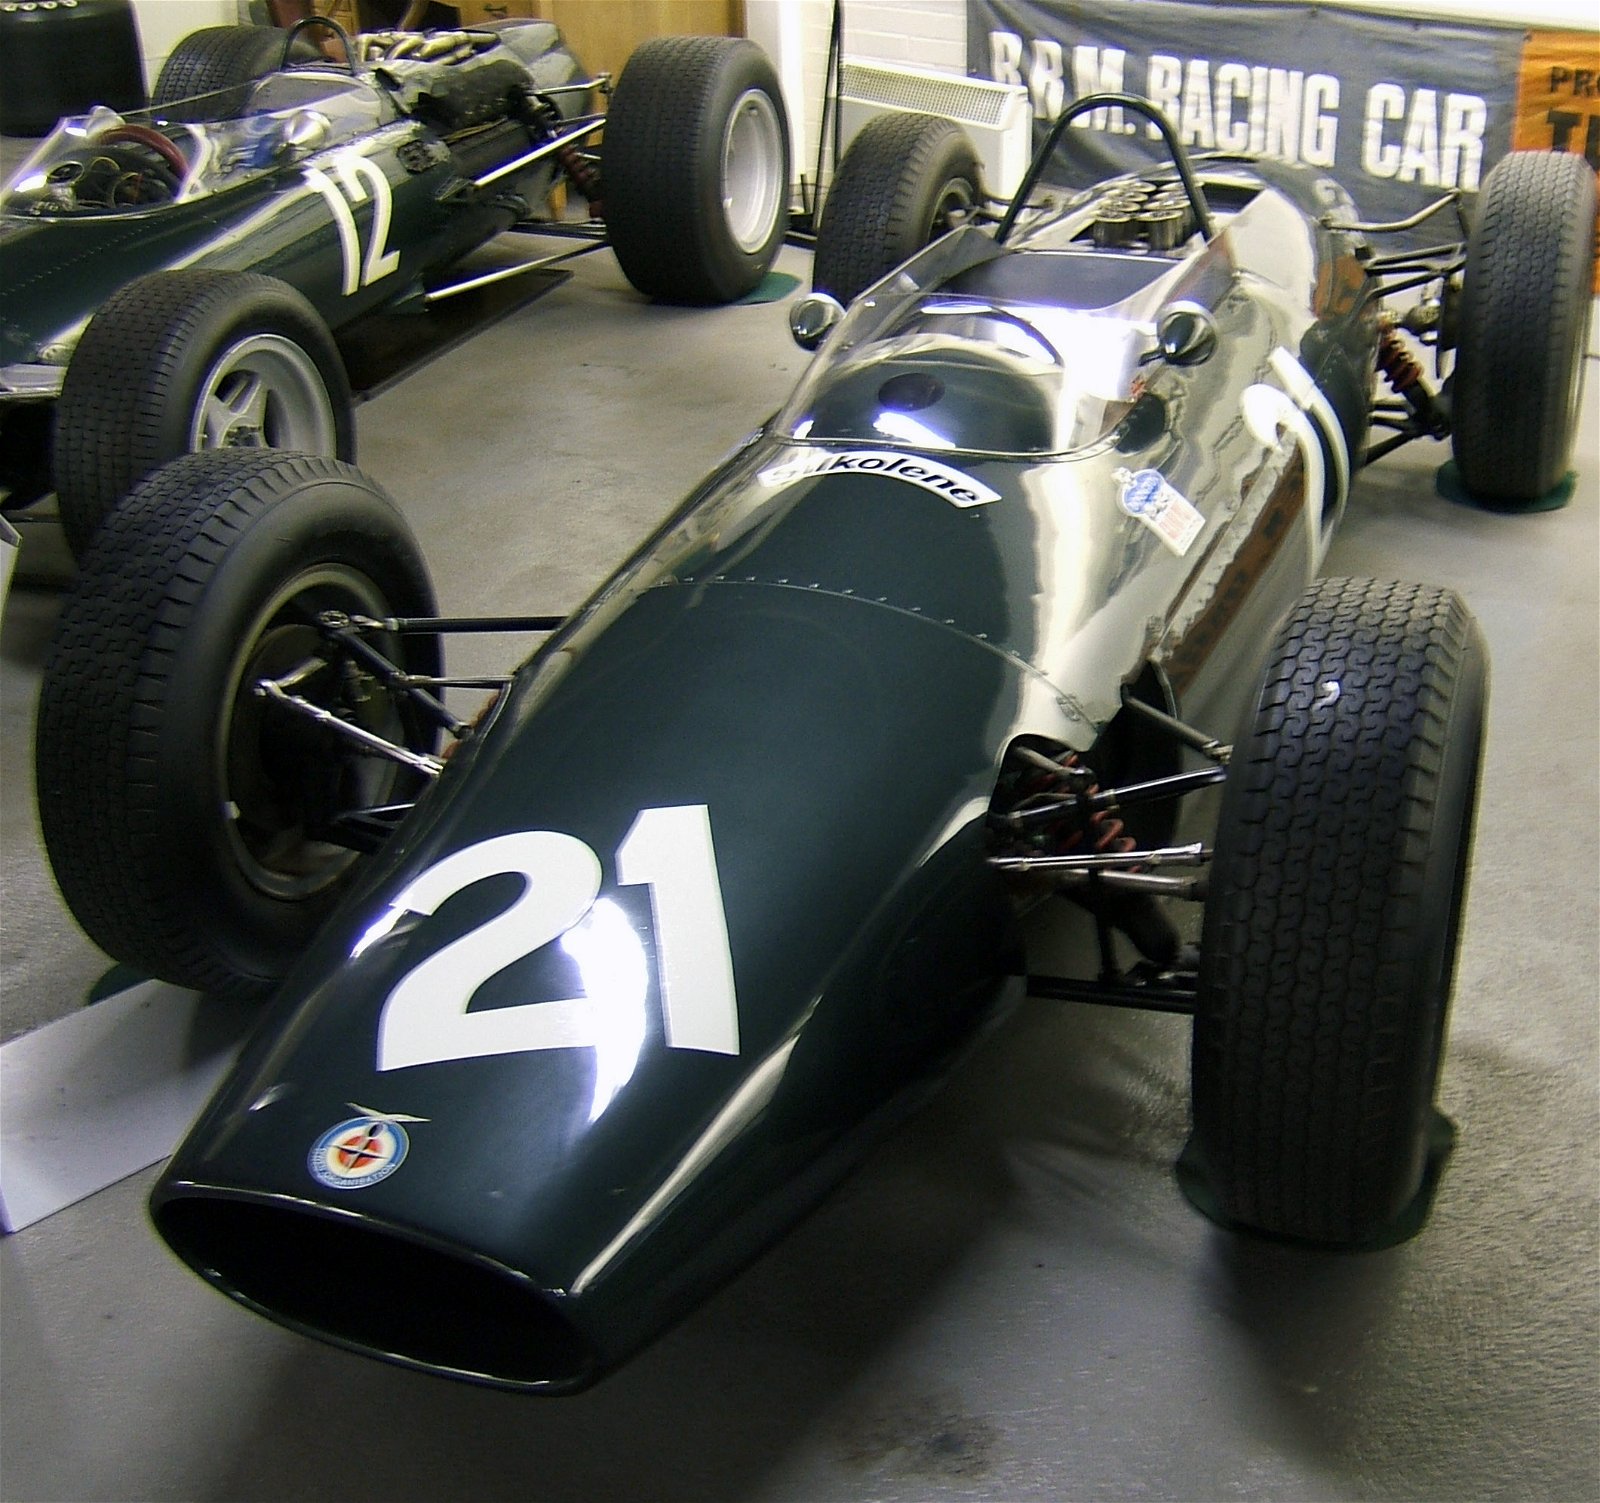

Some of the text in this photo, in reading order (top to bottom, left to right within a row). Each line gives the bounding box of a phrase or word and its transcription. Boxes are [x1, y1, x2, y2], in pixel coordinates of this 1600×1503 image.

[1146, 54, 1340, 168] RACING
[1361, 82, 1487, 192] CAR
[301, 154, 400, 297] 12
[376, 804, 740, 1072] 21
